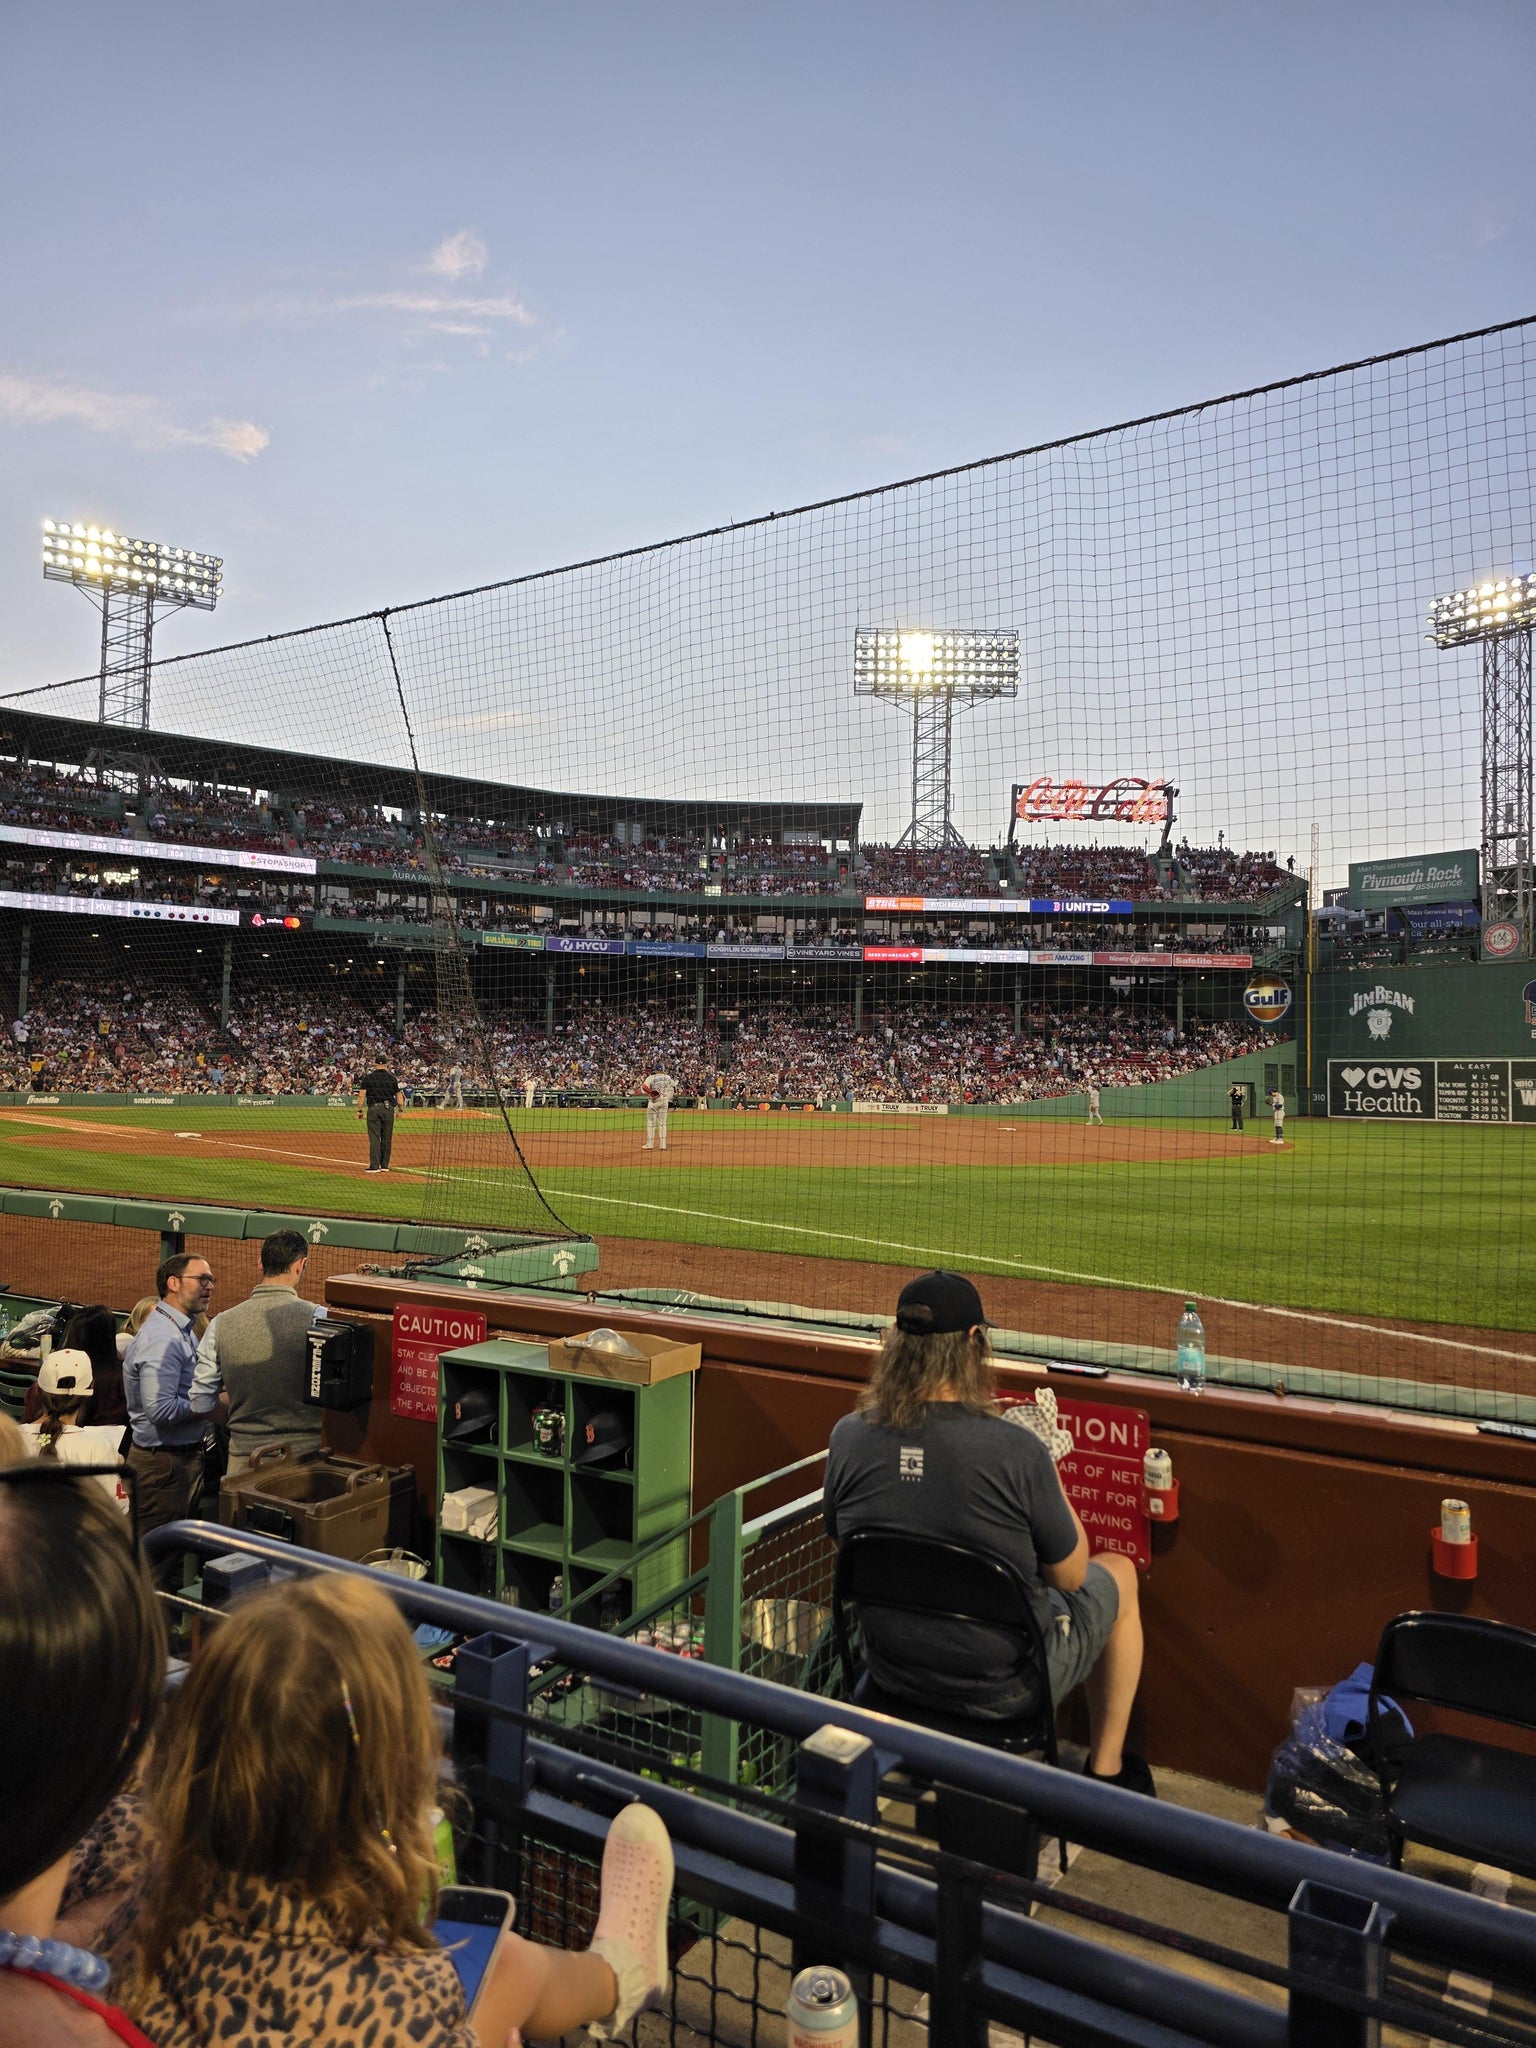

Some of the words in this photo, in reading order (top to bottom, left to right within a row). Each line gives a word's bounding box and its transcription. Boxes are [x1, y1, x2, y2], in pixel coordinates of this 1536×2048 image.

[1361, 868, 1424, 889] Plymouth
[1427, 864, 1463, 882] Rock
[1415, 879, 1463, 891] assurance
[1065, 902, 1110, 911] UNITED
[576, 941, 609, 951] HYCU
[1175, 956, 1212, 965] Safelite
[1245, 989, 1289, 1006] Gulf
[1349, 991, 1375, 1016] JIM
[1374, 985, 1416, 1015] BEAM
[1366, 1066, 1422, 1089] CVS
[1312, 1093, 1326, 1102] 310
[1343, 1091, 1423, 1113] Health
[1471, 1097, 1480, 1105] 34
[399, 1314, 480, 1342] CAUTION!
[397, 1348, 415, 1359] STAY
[418, 1351, 439, 1362] CLEA
[397, 1365, 414, 1376] AND
[416, 1368, 428, 1378] BE
[400, 1382, 437, 1397] OBJECTS
[397, 1397, 413, 1410] THE
[1084, 1464, 1105, 1478] OF
[1111, 1469, 1140, 1485] NET
[1105, 1491, 1137, 1508] FOR
[1080, 1509, 1132, 1530] EAVING
[1095, 1535, 1137, 1555] FIELD
